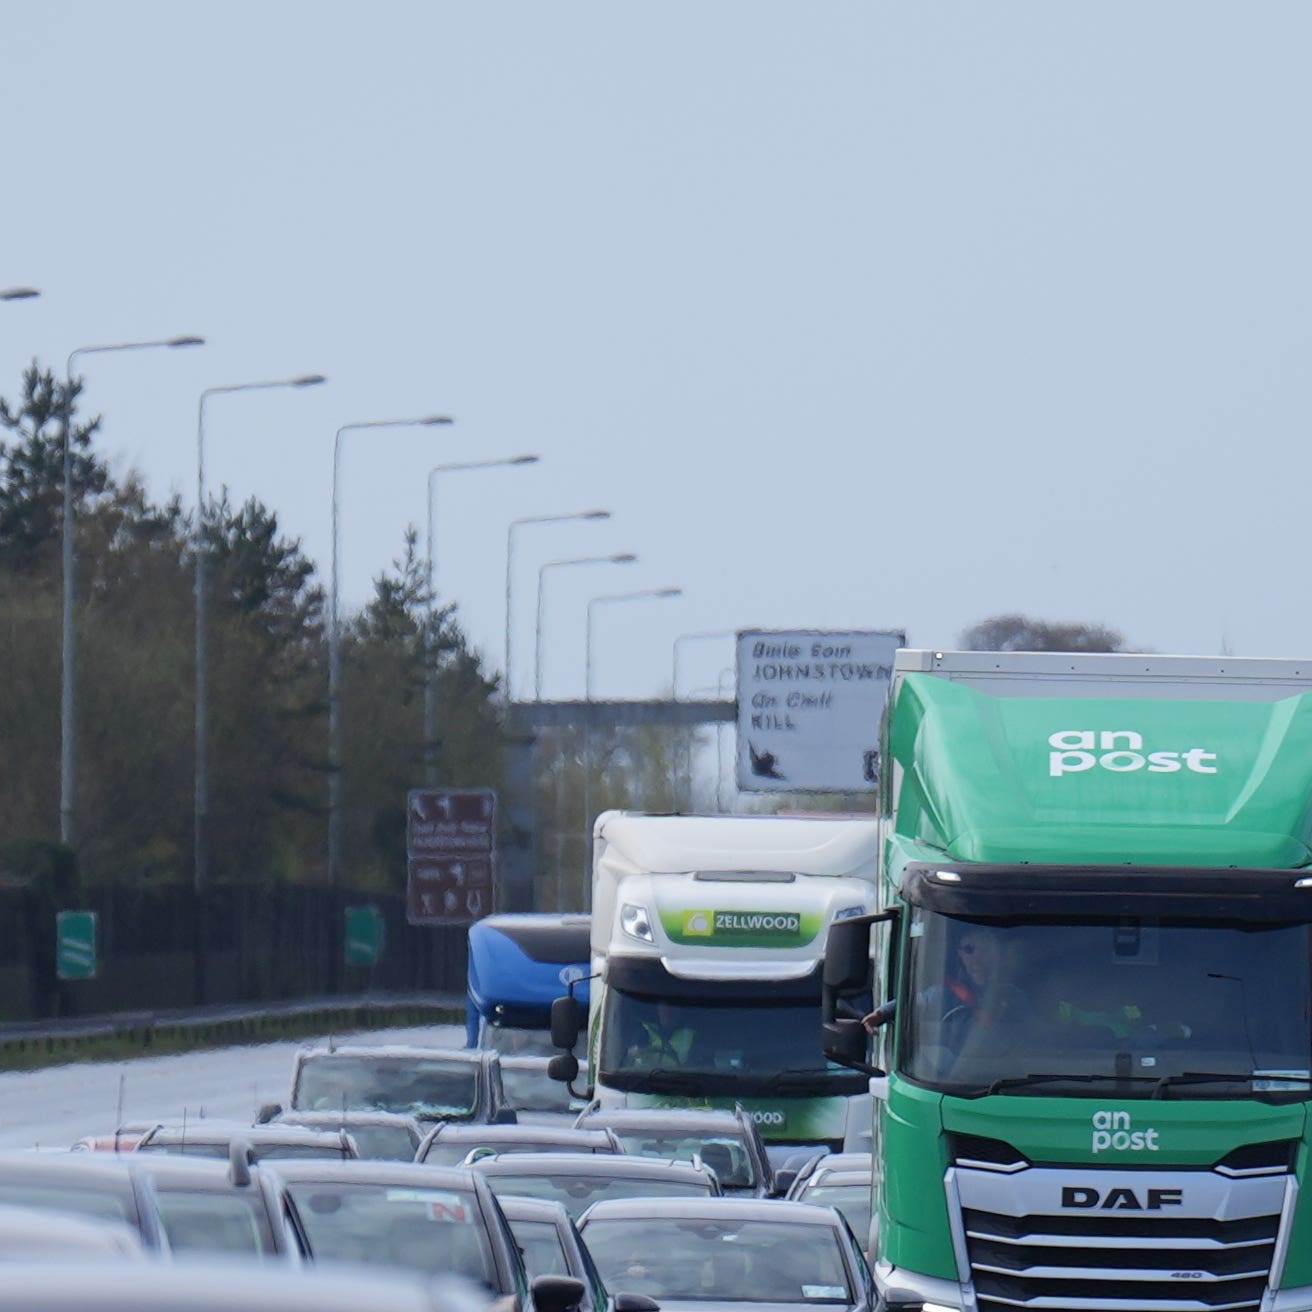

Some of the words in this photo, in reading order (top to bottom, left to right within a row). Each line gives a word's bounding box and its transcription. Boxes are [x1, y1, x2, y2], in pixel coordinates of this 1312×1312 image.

[752, 664, 893, 681] JOHNSTOWN
[751, 712, 795, 730] KILL
[1048, 730, 1143, 750] an
[1049, 748, 1218, 777] post
[715, 914, 799, 930] ZELLWOOD
[1092, 1110, 1131, 1130] an
[1092, 1128, 1160, 1154] post
[1061, 1187, 1184, 1210] DAF
